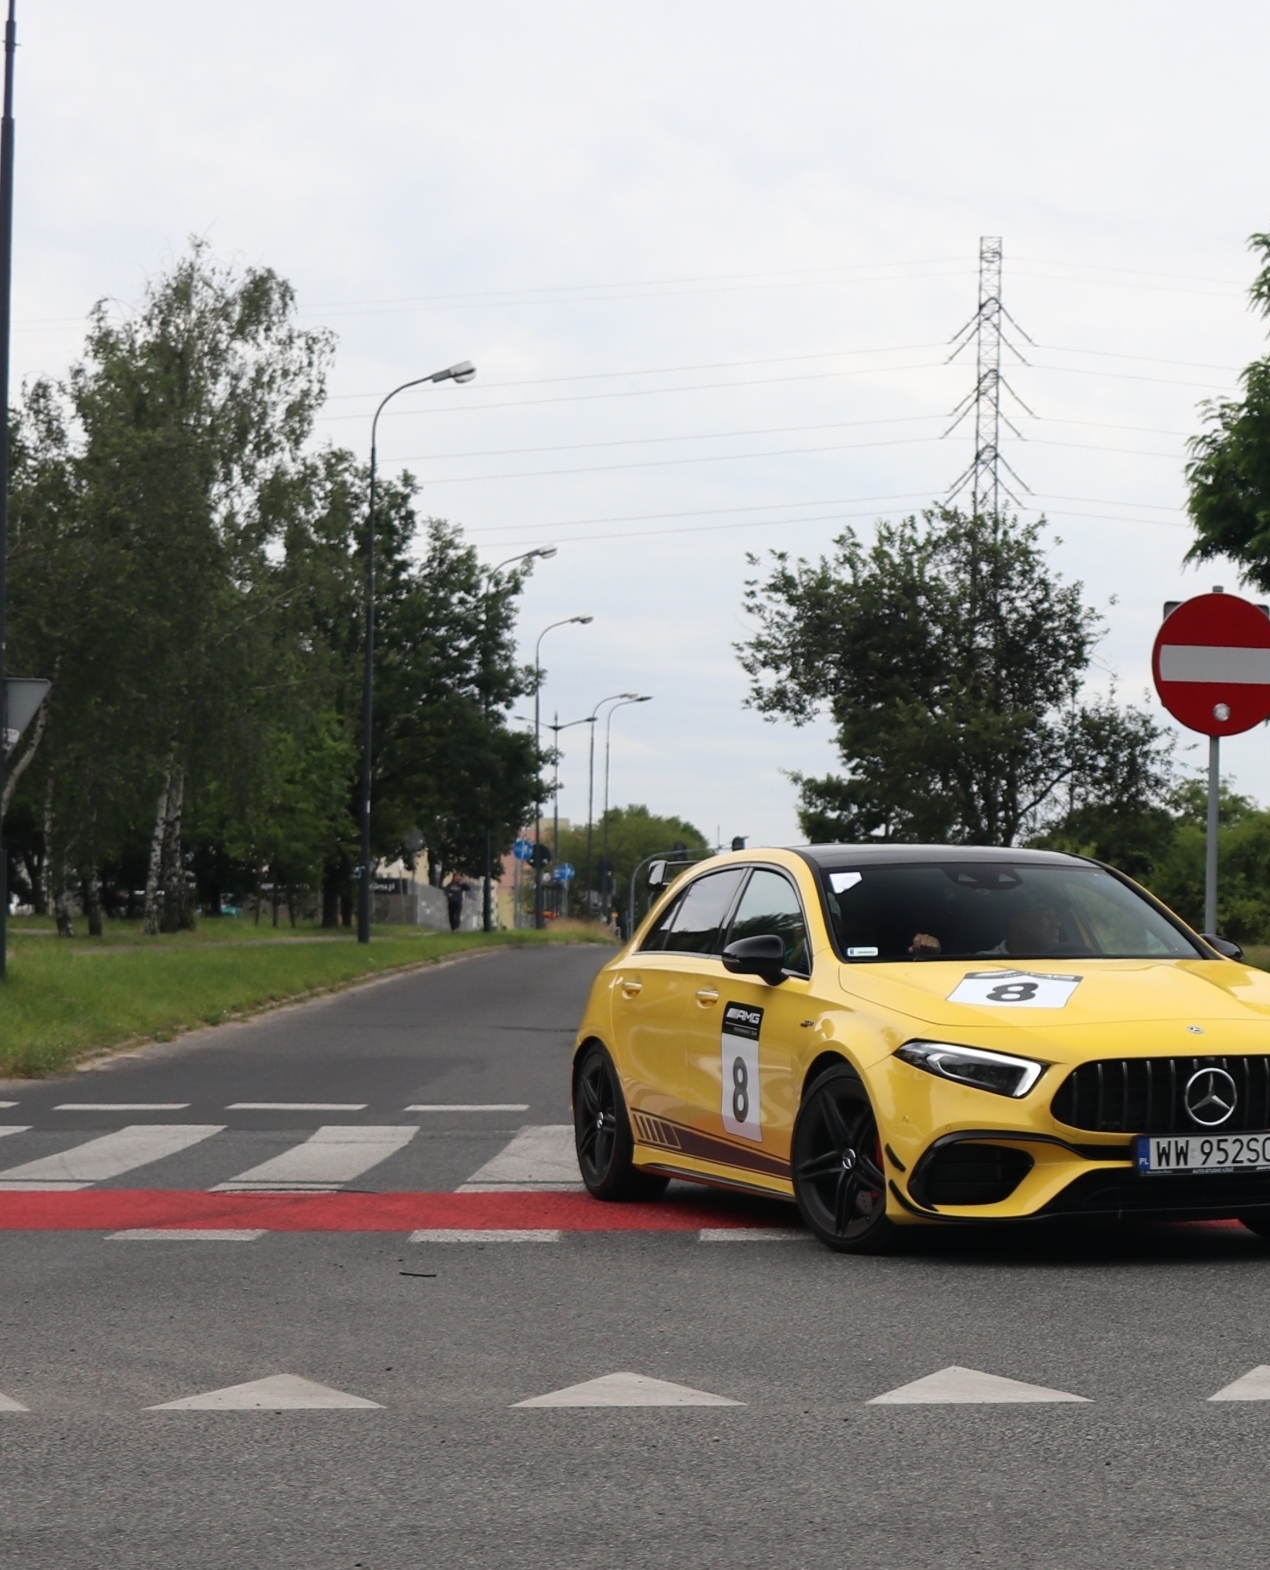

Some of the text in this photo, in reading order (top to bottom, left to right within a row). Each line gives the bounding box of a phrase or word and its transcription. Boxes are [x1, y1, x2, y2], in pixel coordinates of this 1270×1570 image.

[986, 982, 1039, 1002] 8
[736, 1009, 761, 1025] AMG
[732, 1056, 749, 1123] 8
[1139, 1157, 1149, 1165] PL
[1156, 1139, 1189, 1167] WW
